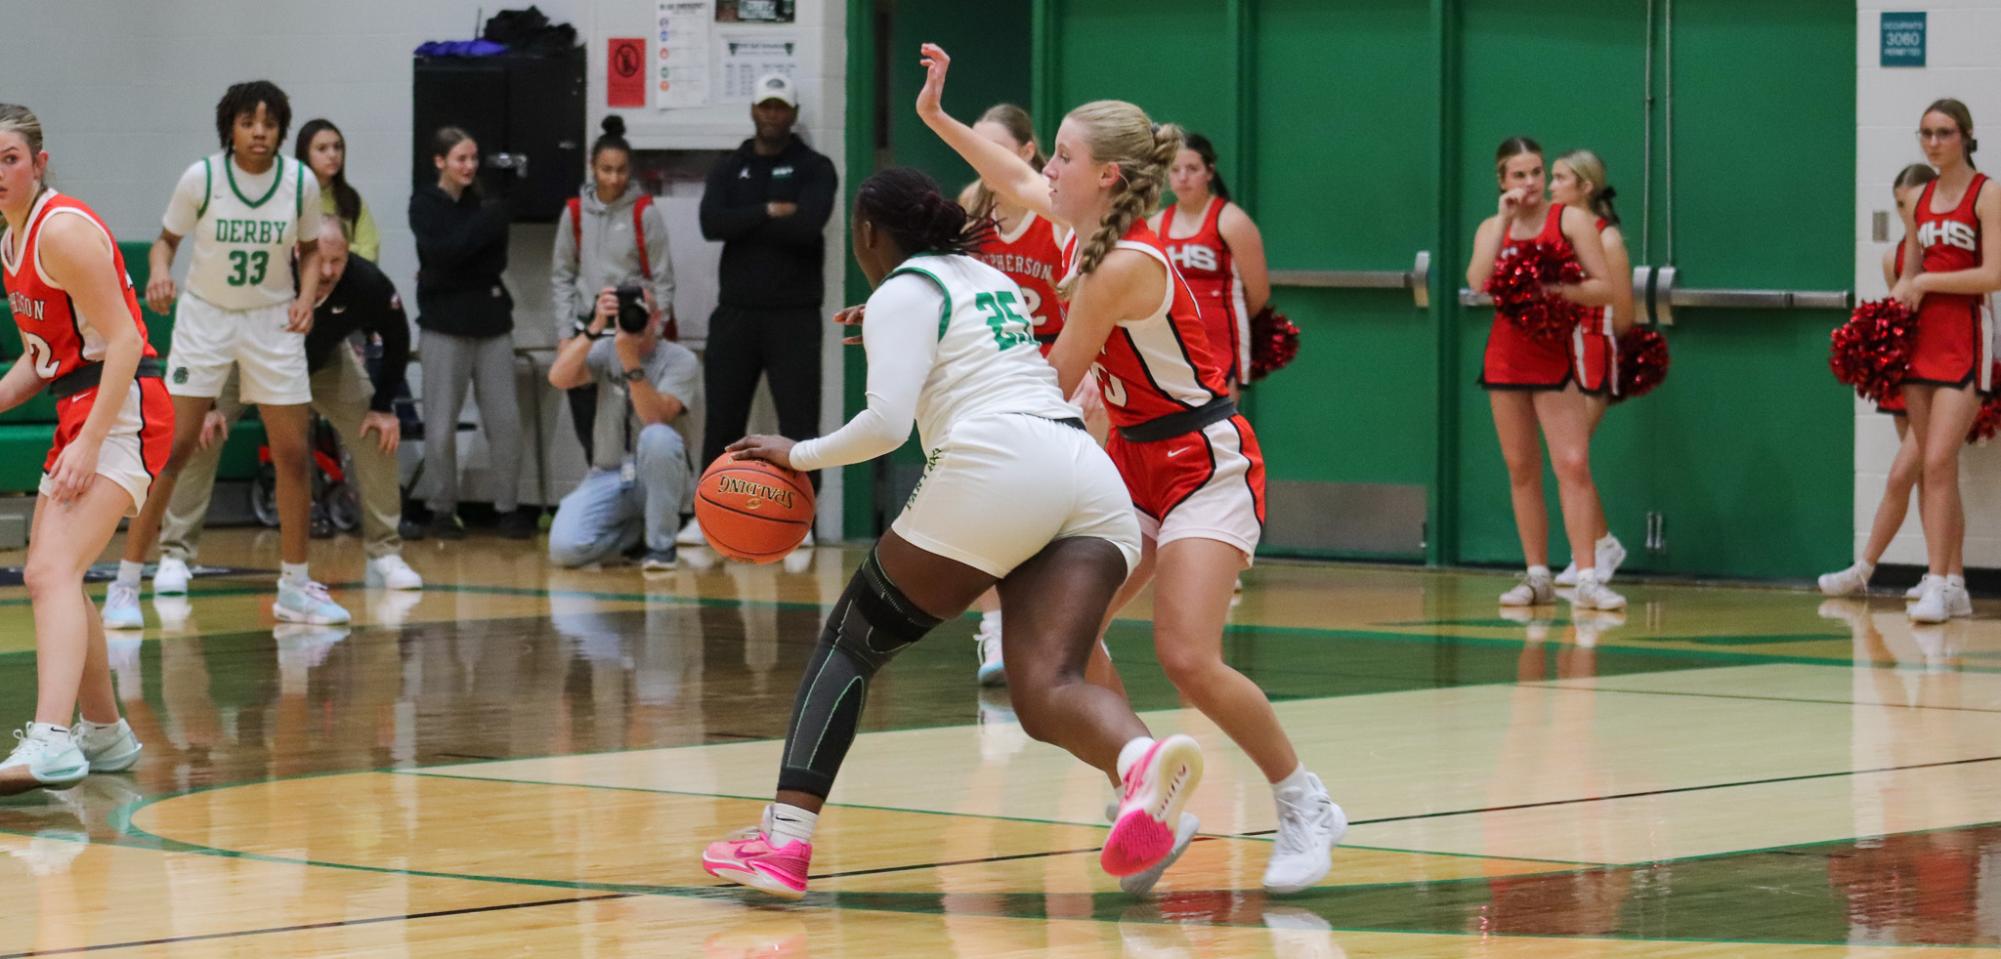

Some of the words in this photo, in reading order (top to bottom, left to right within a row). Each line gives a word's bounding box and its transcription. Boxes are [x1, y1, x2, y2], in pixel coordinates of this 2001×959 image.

[1886, 32, 1920, 46] 3060
[216, 219, 287, 244] DERBY
[227, 250, 270, 286] 33
[1165, 243, 1217, 271] HS
[719, 475, 794, 508] SPALDING
